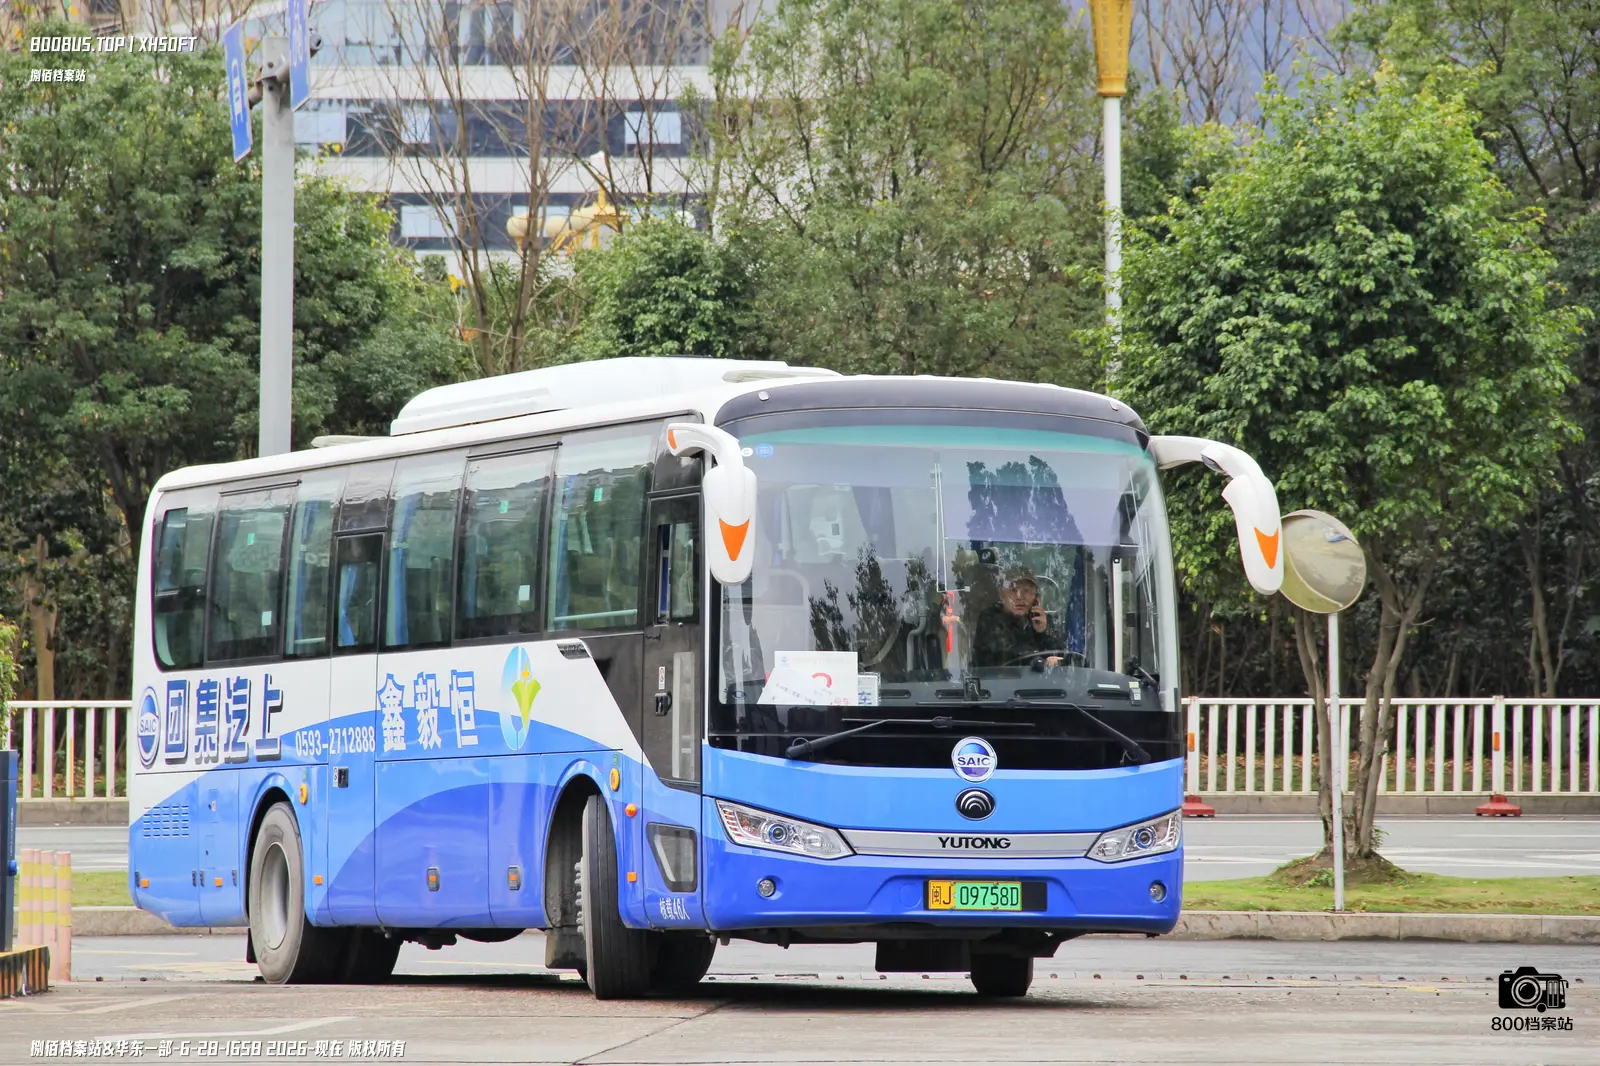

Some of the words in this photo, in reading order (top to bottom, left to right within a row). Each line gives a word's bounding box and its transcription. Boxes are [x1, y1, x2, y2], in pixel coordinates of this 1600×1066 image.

[139, 719, 157, 733] SAIC
[295, 725, 375, 757] 0593-2712888
[957, 756, 991, 767] SAIC
[938, 836, 1012, 849] YUTONG
